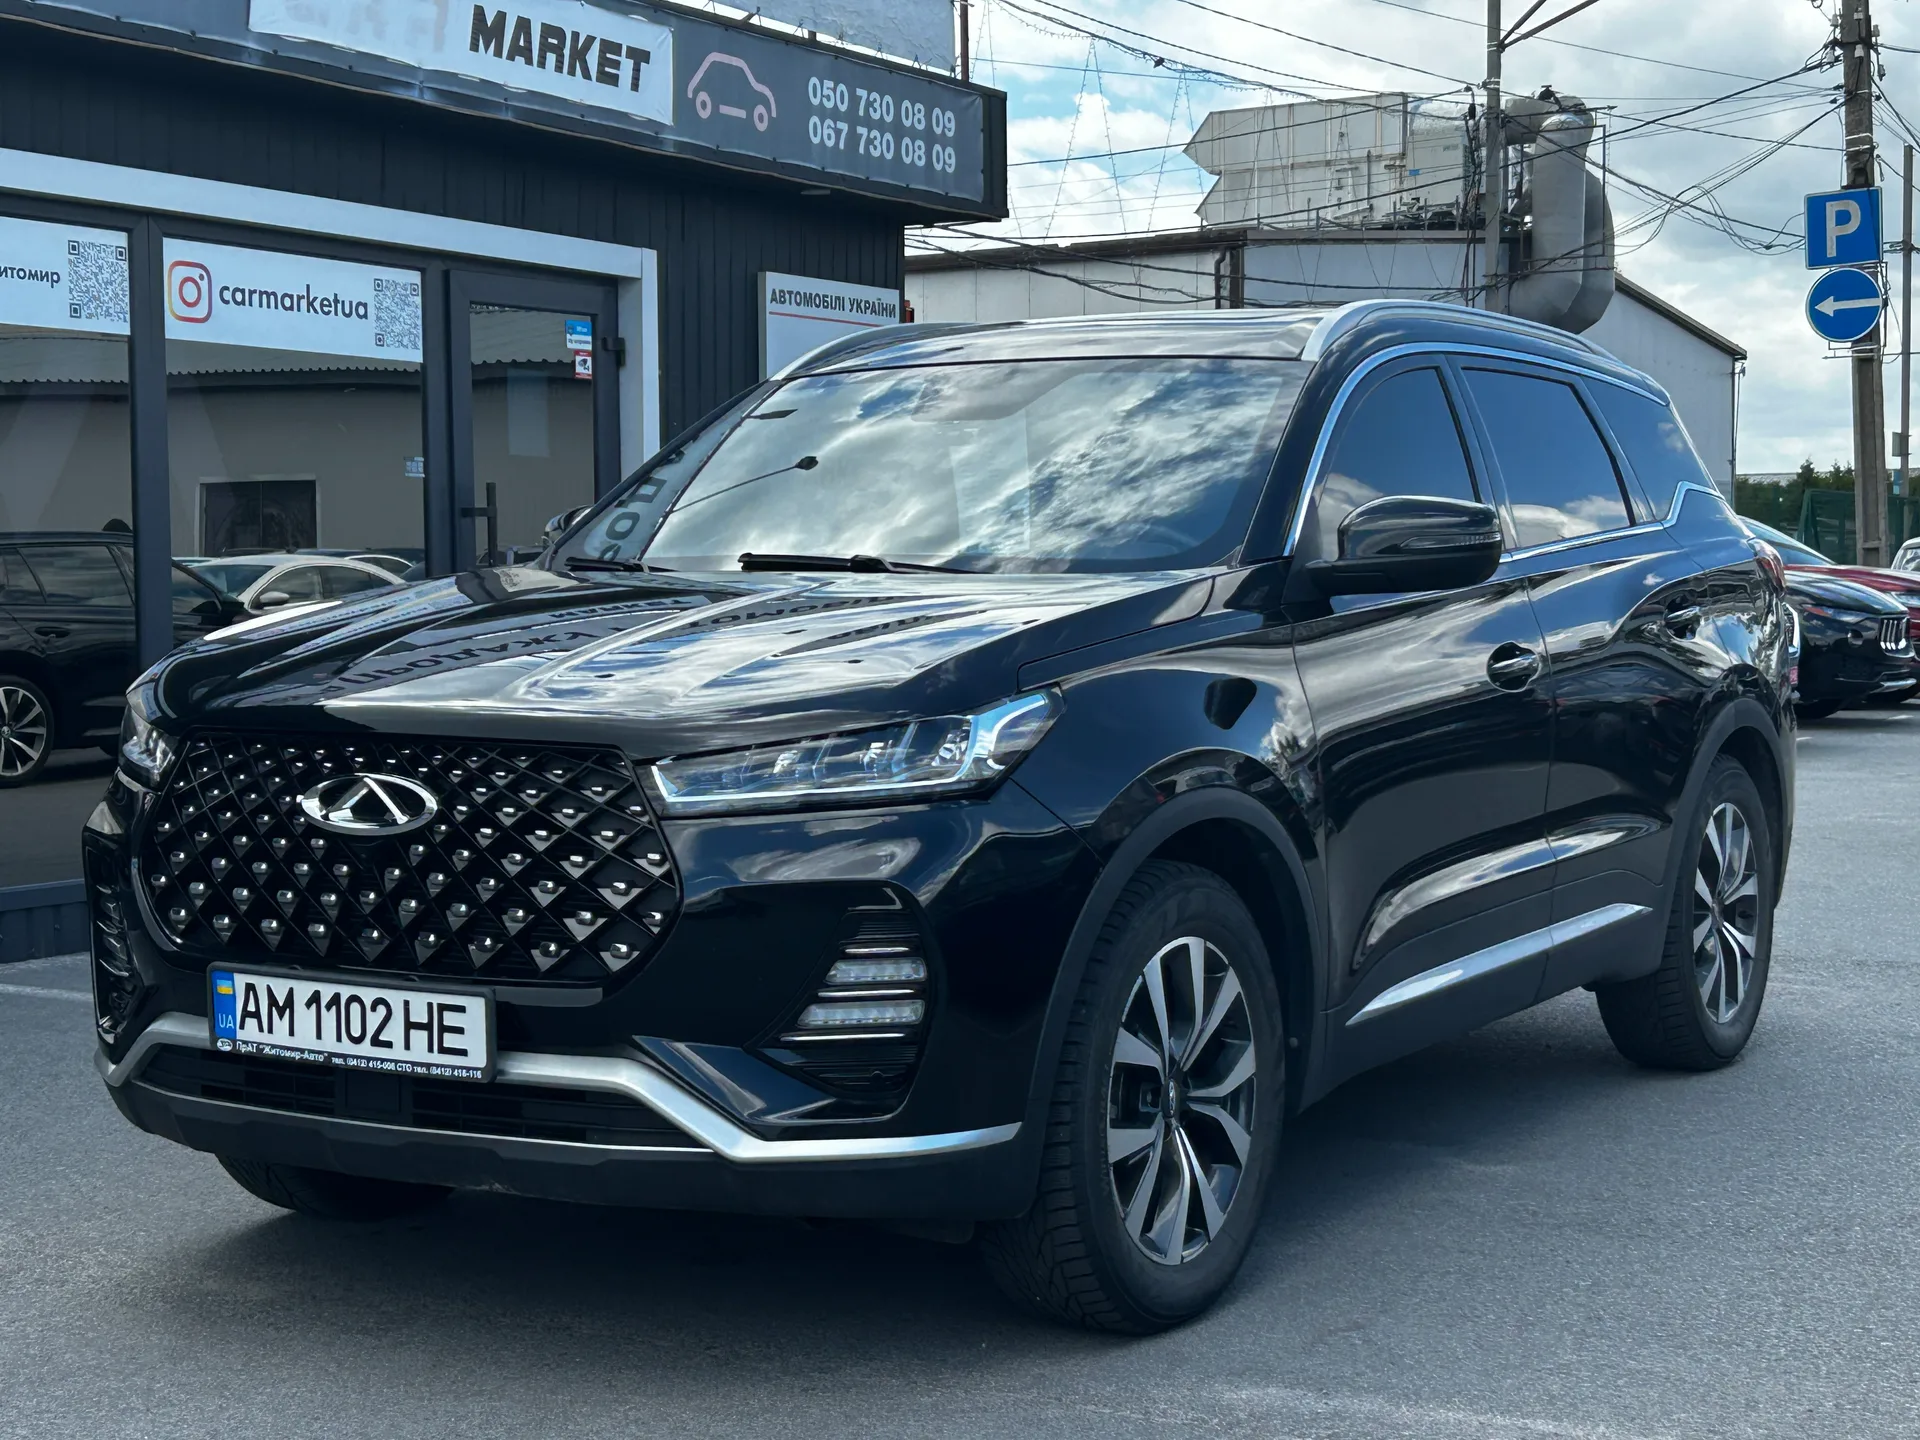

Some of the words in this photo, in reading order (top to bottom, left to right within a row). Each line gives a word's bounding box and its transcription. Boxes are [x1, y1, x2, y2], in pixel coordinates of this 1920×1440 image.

[469, 3, 651, 92] MARKET
[807, 76, 849, 112] 050
[856, 88, 894, 123] 730
[901, 100, 926, 131] 08
[932, 107, 956, 138] 09
[808, 115, 849, 150] 067
[856, 128, 894, 160] 730
[901, 137, 926, 167] 08
[932, 145, 956, 173] 09
[1825, 199, 1861, 258] P
[0, 265, 61, 289] итомир
[219, 282, 369, 321] carmarketua
[769, 288, 846, 313] АВТОМОБІЛІ
[848, 294, 897, 320] УКРАЇНИ
[218, 1013, 235, 1030] UA
[238, 982, 295, 1037] AM
[304, 989, 394, 1049] 1102
[403, 999, 469, 1057] HE
[236, 1041, 258, 1053] ПрАТ
[397, 1063, 412, 1072] СТО
